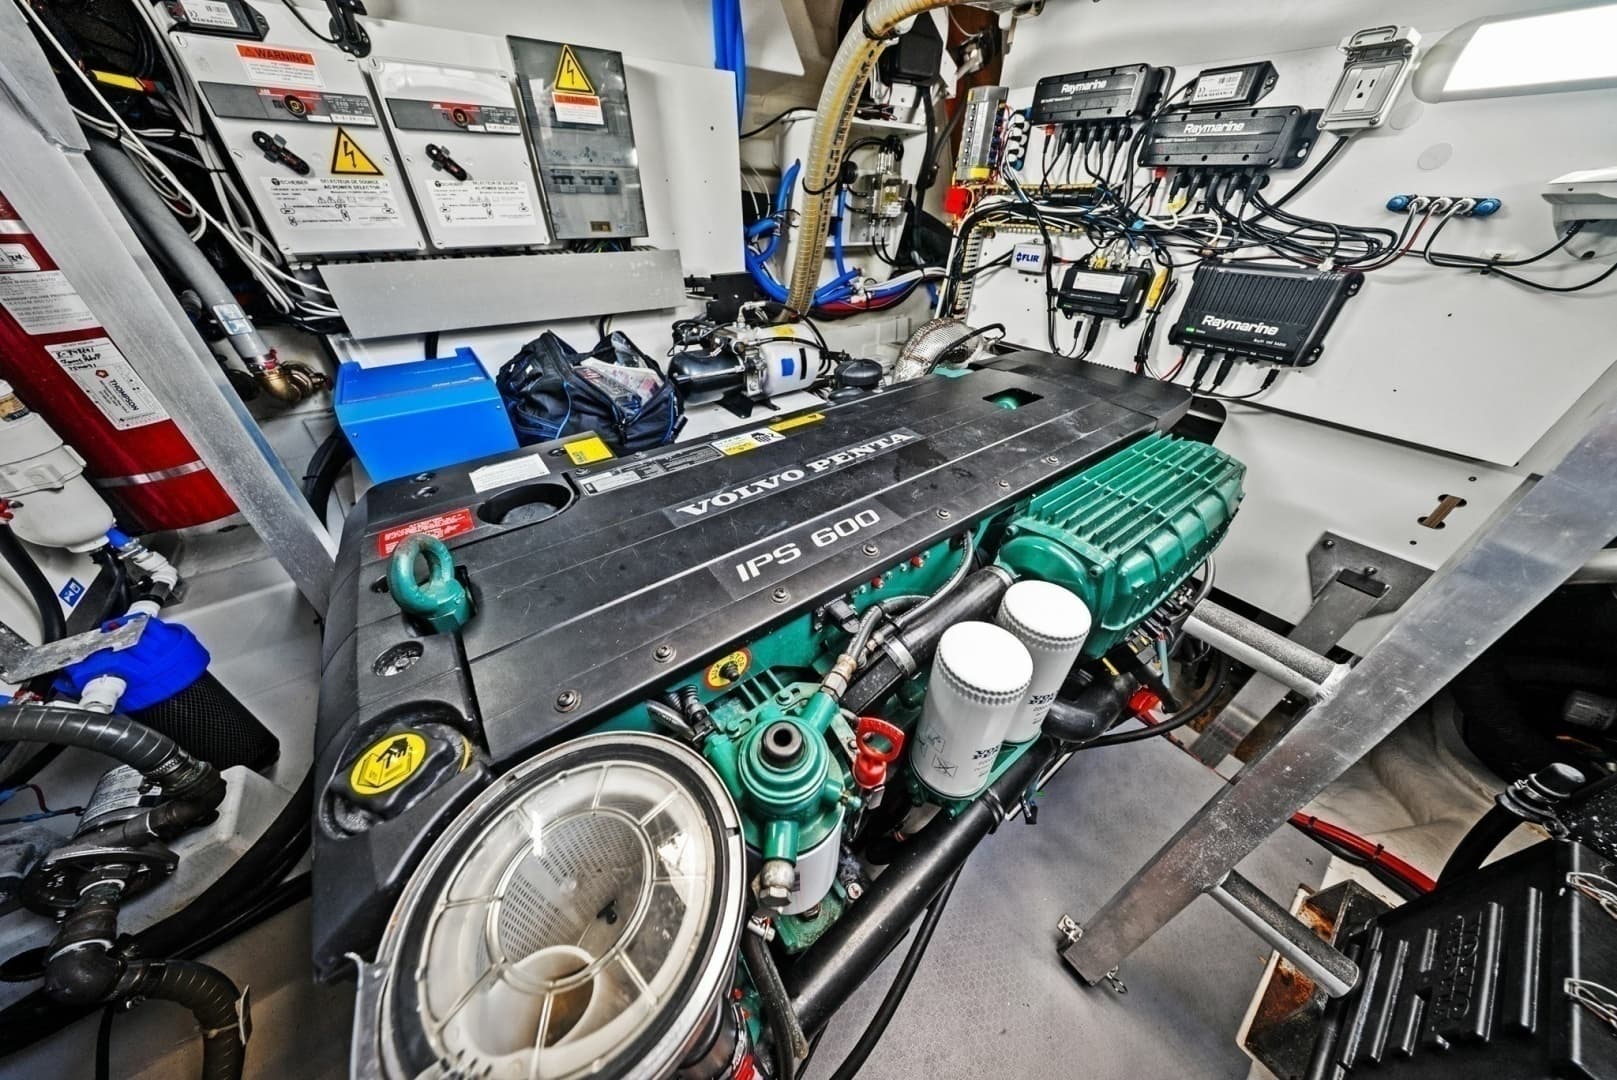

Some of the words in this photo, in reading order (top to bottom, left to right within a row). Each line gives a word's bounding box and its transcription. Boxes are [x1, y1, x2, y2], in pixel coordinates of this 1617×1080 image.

[255, 49, 308, 63] WARNING
[1061, 79, 1108, 95] Raymarine
[1183, 121, 1245, 135] Raymarine
[1022, 253, 1040, 263] FLIR
[1201, 314, 1279, 336] Raymarine
[110, 379, 140, 411] THOMPSON
[676, 469, 805, 516] VOLVO
[806, 432, 914, 473] PENTA
[735, 542, 802, 583] IPS
[810, 509, 881, 548] 600
